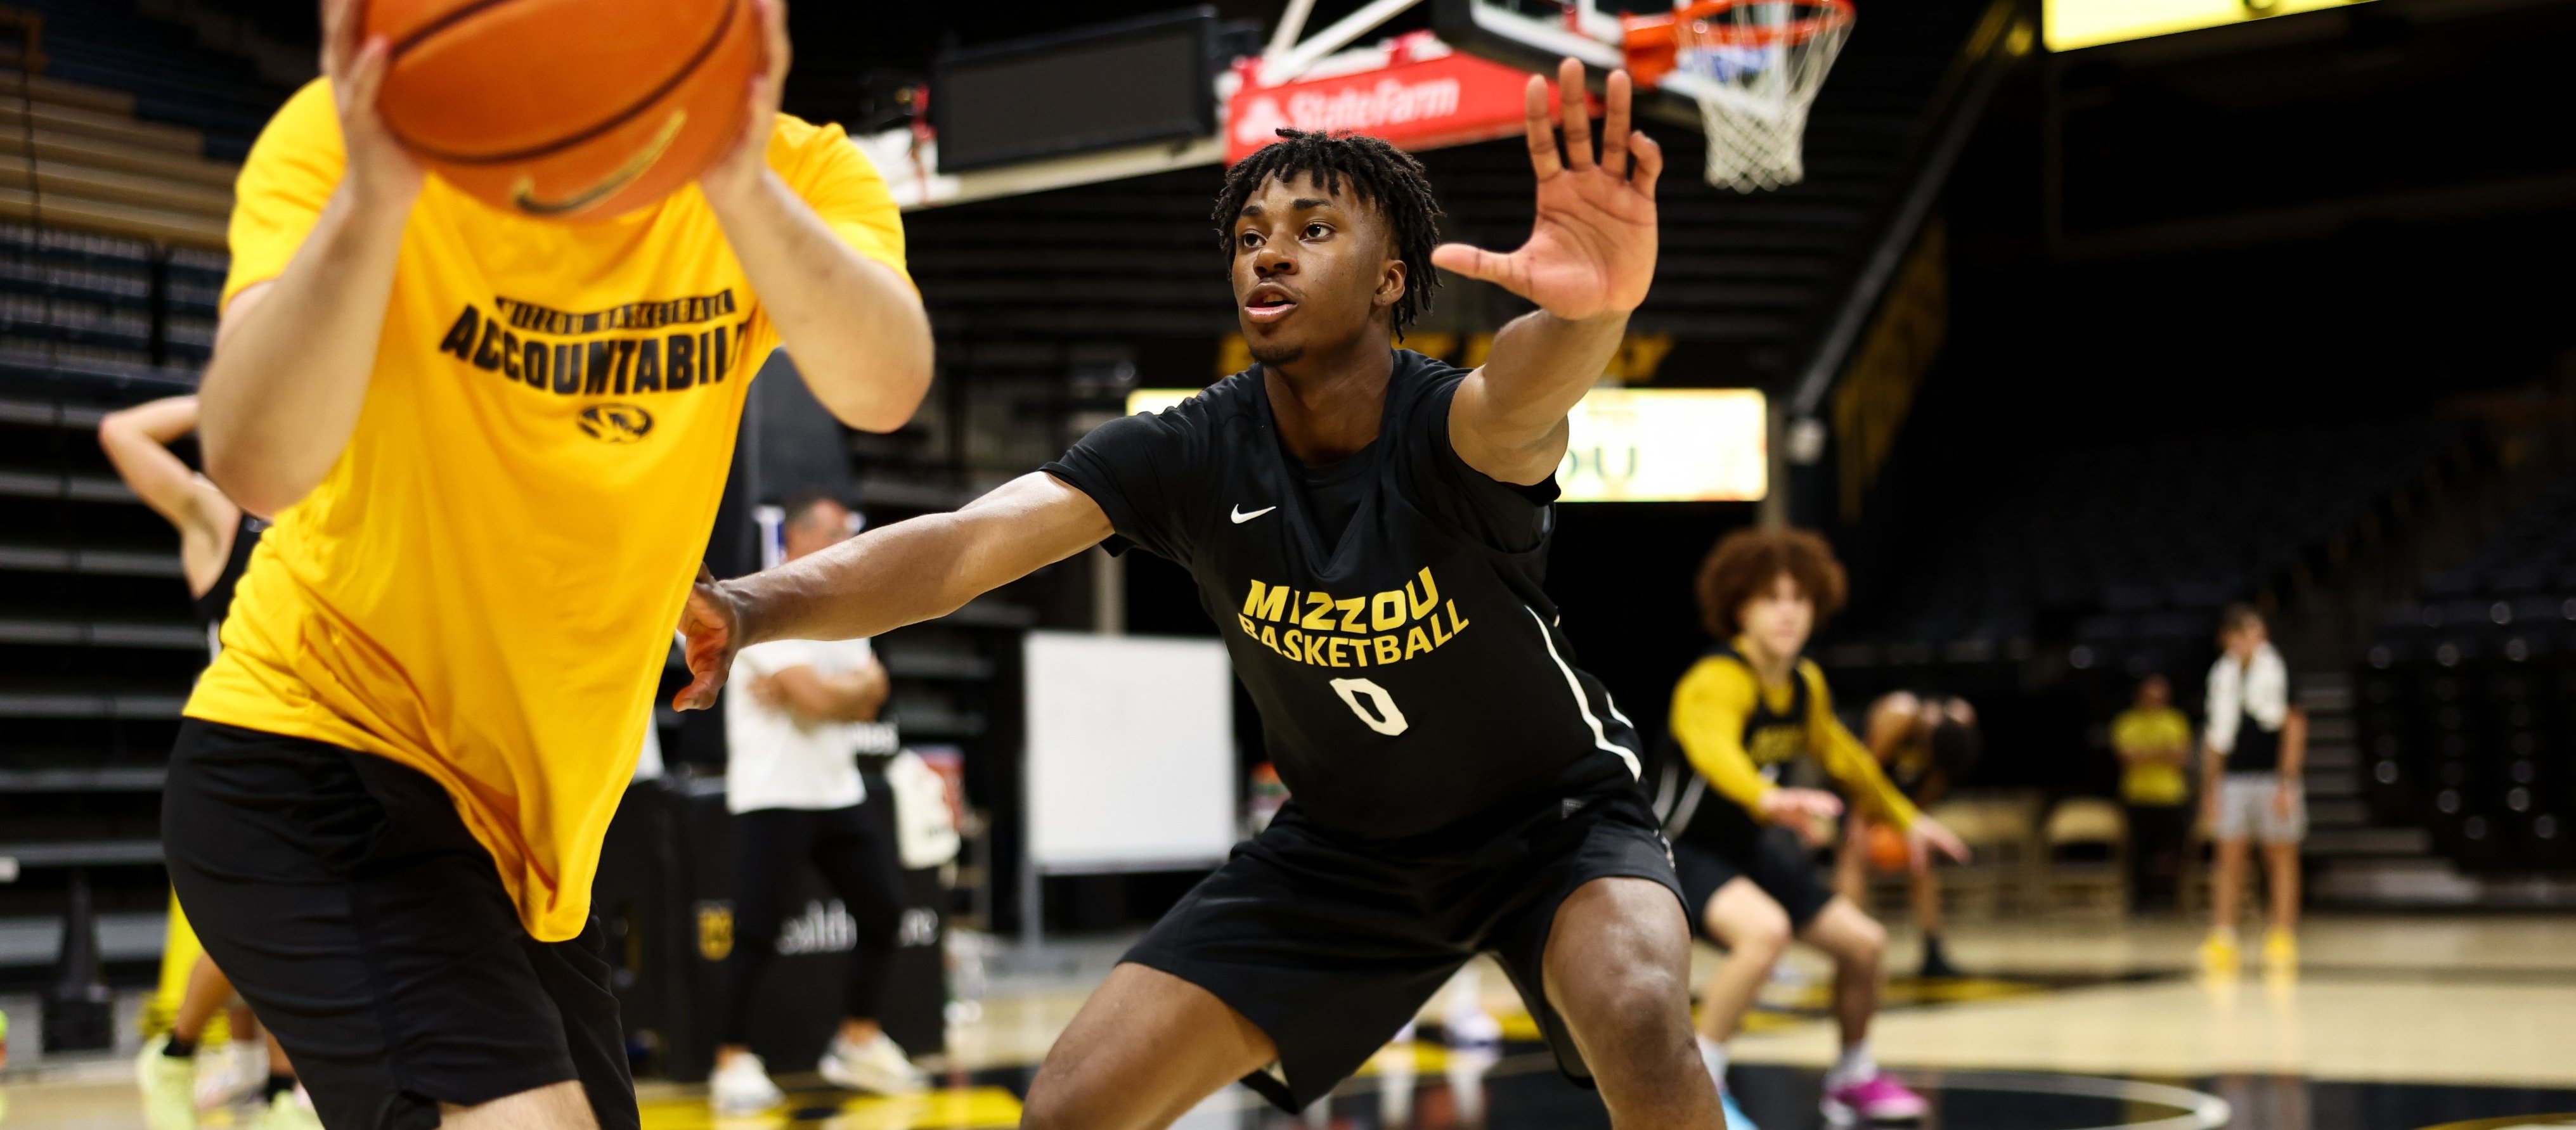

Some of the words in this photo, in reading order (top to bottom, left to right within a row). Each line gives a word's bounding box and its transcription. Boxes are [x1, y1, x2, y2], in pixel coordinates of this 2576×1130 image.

[500, 300, 584, 335] MIZZOU
[597, 290, 734, 330] BASKETBALL
[439, 304, 746, 395] ACCOUNTABIL
[1237, 598, 1470, 667] BASKETBALL
[1242, 565, 1439, 634] MIZZOU
[1329, 677, 1409, 736] 0
